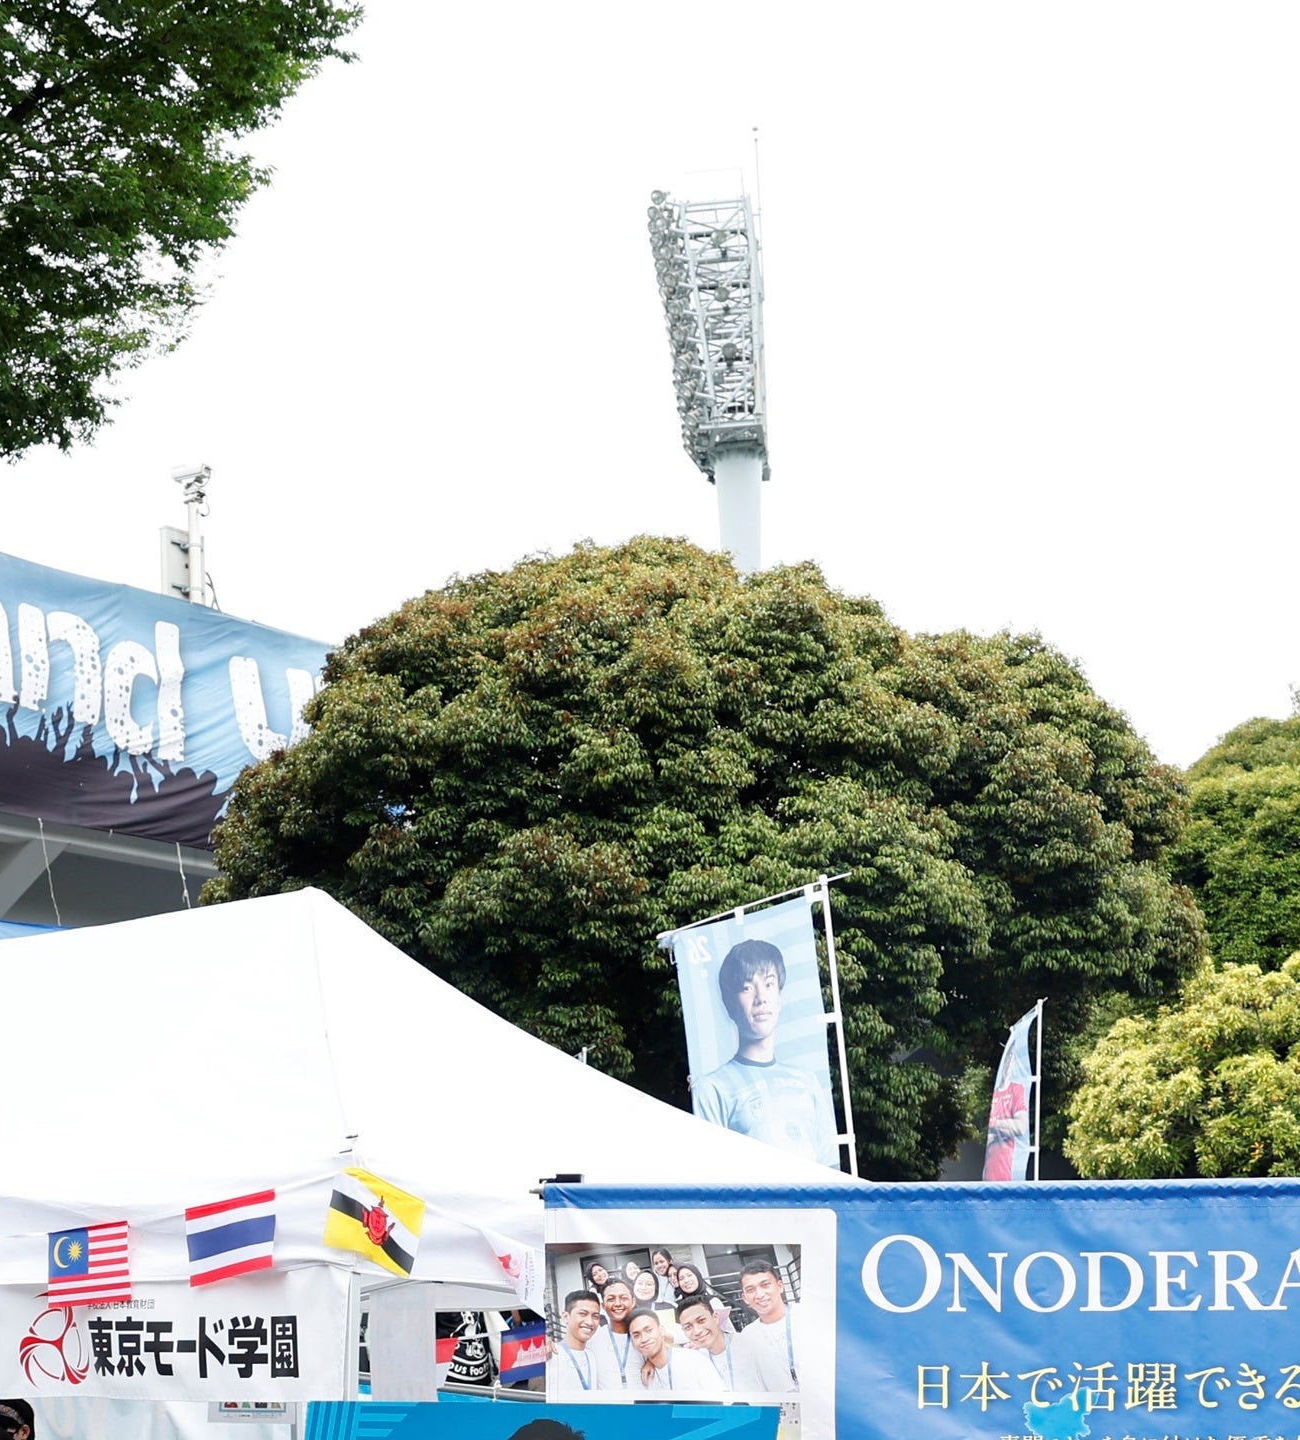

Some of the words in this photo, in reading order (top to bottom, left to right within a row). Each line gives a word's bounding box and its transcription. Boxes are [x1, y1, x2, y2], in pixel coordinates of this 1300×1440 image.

[87, 1315, 299, 1378] 東京モード学園
